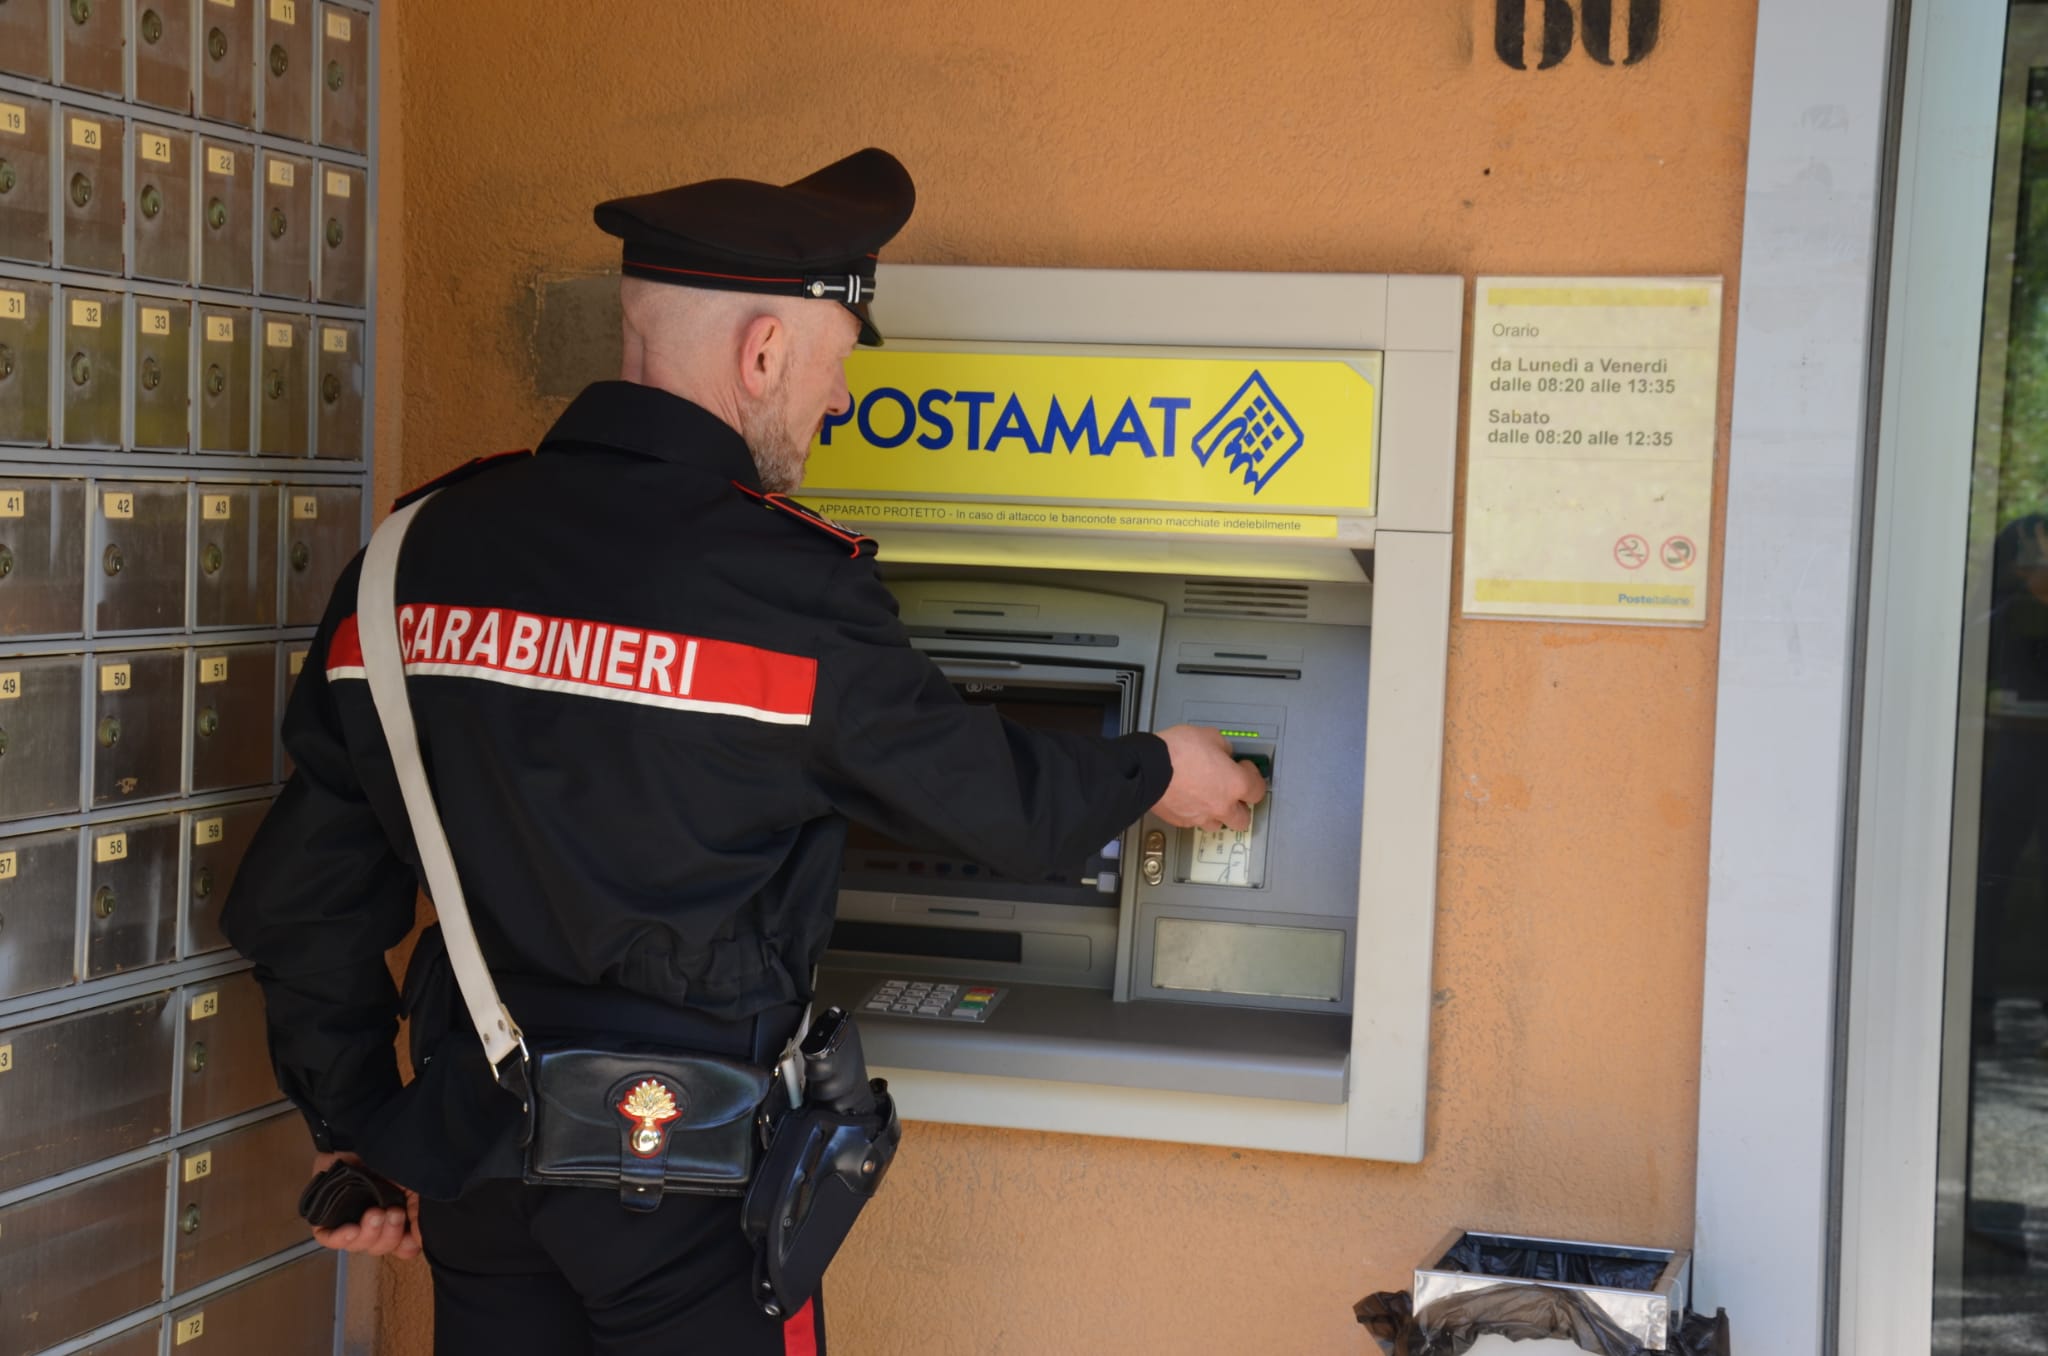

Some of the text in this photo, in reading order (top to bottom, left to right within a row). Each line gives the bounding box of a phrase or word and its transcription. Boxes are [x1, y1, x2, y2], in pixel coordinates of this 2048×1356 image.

[283, 5, 292, 19] 11
[8, 113, 21, 129] 19
[84, 130, 97, 145] 20
[155, 141, 167, 157] 21
[220, 156, 231, 170] 22
[8, 299, 21, 314] 31
[86, 308, 98, 323] 32
[155, 315, 167, 329] 33
[219, 323, 230, 336] 34
[278, 329, 288, 343] 35
[1492, 324, 1539, 338] Orario
[1490, 358, 1668, 374] da Lunedì a Venerdì
[1490, 377, 1676, 394] dalle 08:20 alle 13:35
[820, 387, 1191, 457] POSTAMAT
[1488, 409, 1551, 425] Sabato
[1487, 430, 1673, 446] dalle 08:20 alle 12:35
[7, 497, 20, 512] 41
[117, 500, 130, 513] 42
[216, 501, 227, 514] 43
[304, 502, 315, 513] 44
[818, 504, 880, 516] APPARATO
[884, 507, 946, 519] PROTETTO
[956, 509, 966, 519] In
[969, 512, 993, 520] caso
[997, 510, 1006, 521] di
[1008, 511, 1046, 522] attacco
[1050, 513, 1059, 523] le
[1061, 513, 1117, 524] banconote
[1119, 517, 1163, 526] saranno
[1166, 517, 1220, 527] macchiate
[1223, 519, 1301, 530] indelebilmente
[399, 606, 697, 695] CARABINIERI
[214, 663, 225, 677] 51
[2, 679, 16, 693] 49
[114, 672, 127, 686] 50
[208, 824, 220, 838] 59
[110, 840, 123, 854] 58
[0, 858, 11, 874] 57
[203, 999, 215, 1013] 64
[0, 1052, 8, 1066] 3
[196, 1160, 207, 1173] 68
[189, 1321, 200, 1334] 72
